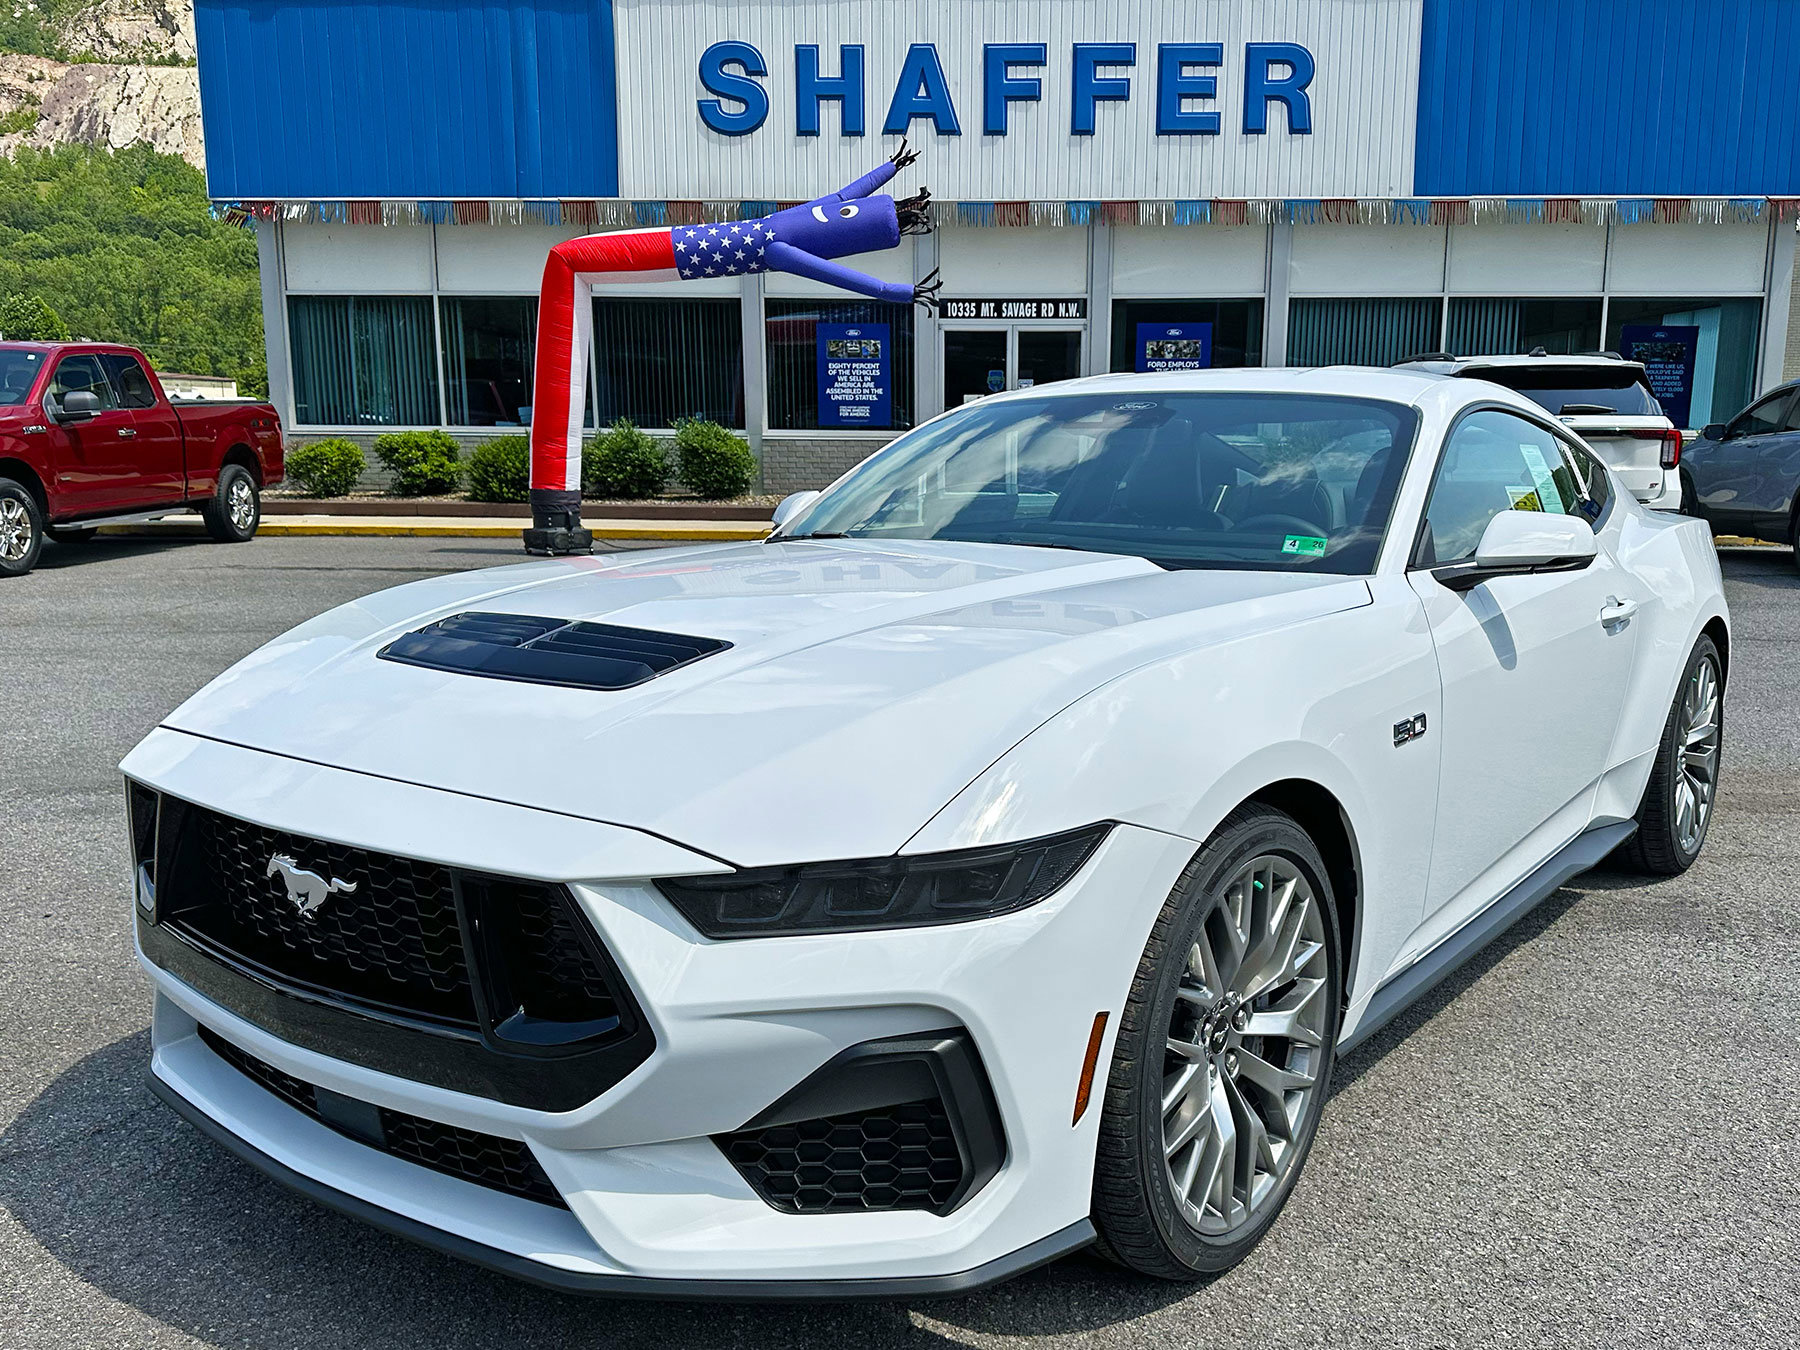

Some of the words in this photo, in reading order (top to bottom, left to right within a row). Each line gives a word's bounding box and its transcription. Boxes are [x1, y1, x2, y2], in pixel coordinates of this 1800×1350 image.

[697, 42, 1313, 137] SHAFFER
[947, 302, 976, 317] 10335
[980, 302, 998, 317] MT.
[1001, 302, 1037, 317] SAVAGE
[1041, 303, 1055, 317] RD
[1058, 303, 1080, 317] N.W.
[1289, 540, 1298, 548] 4
[1393, 712, 1427, 748] 5.0
